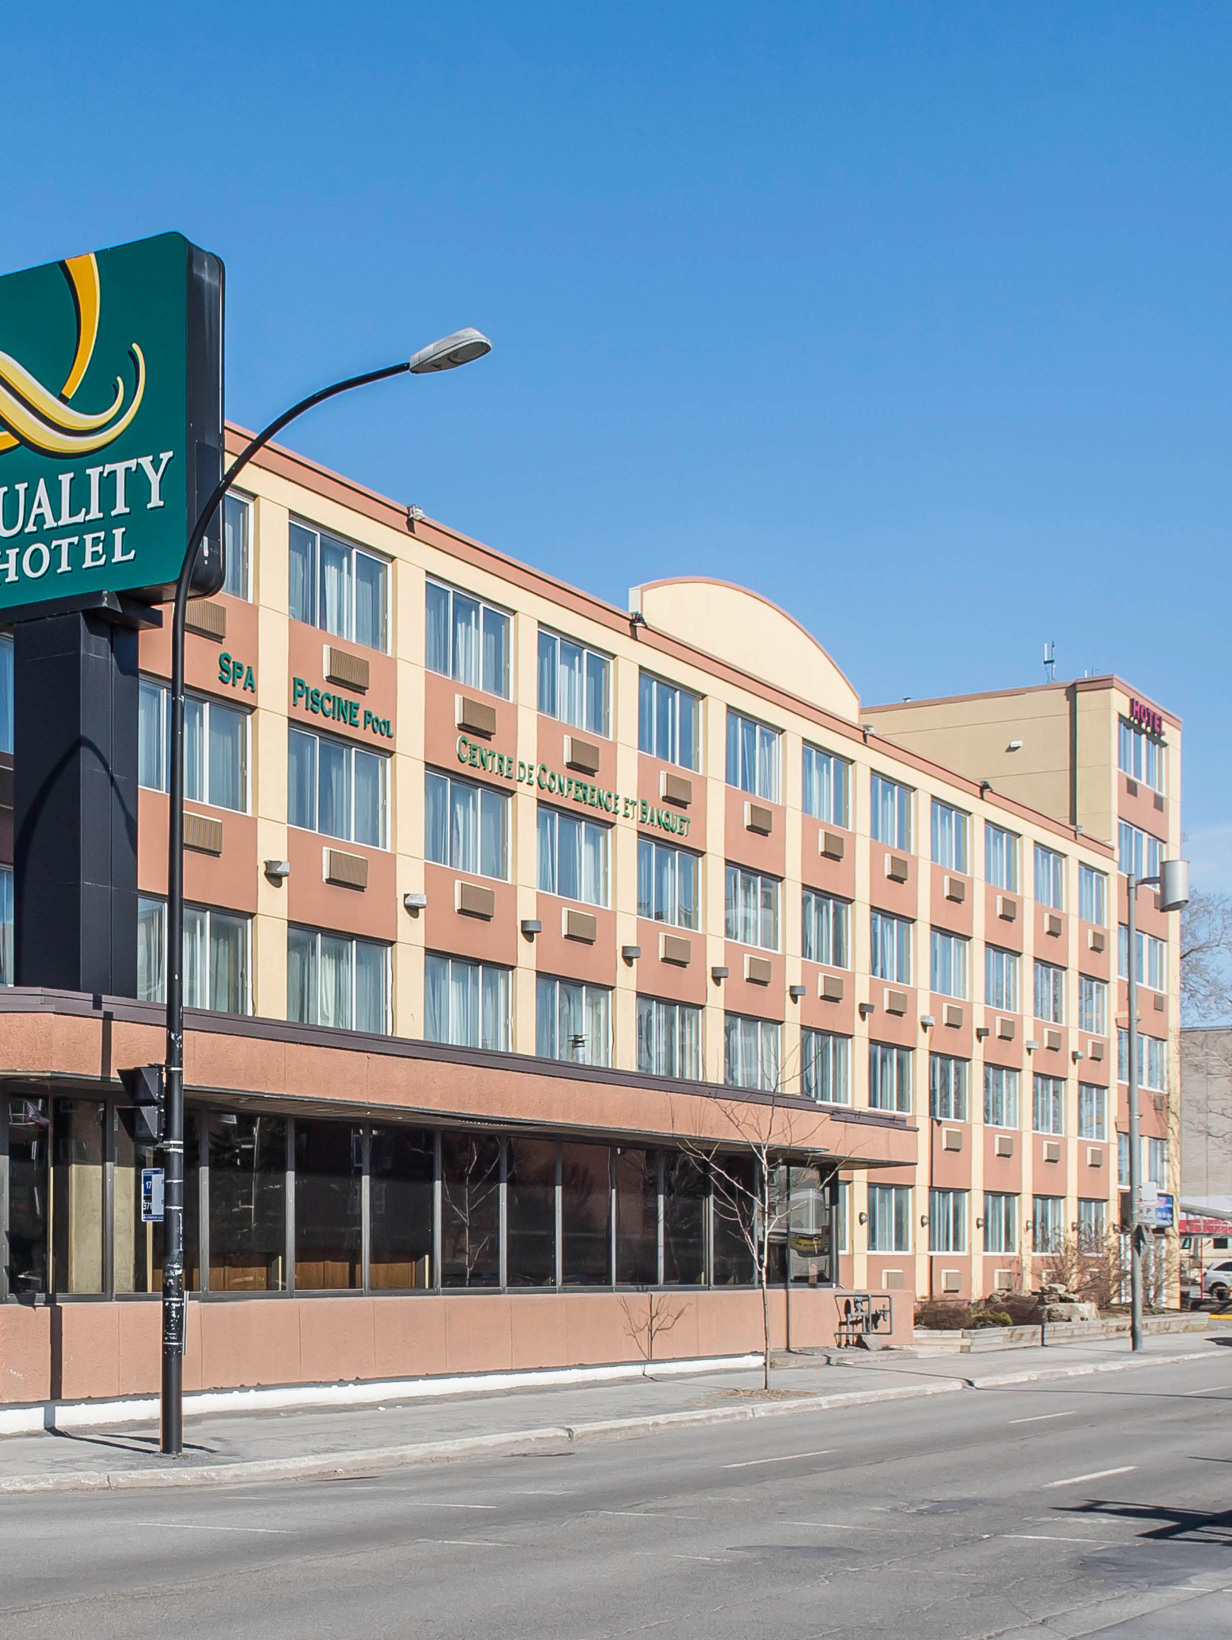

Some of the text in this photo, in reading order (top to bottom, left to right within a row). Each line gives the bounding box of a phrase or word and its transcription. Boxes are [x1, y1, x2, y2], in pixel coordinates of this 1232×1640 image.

[218, 652, 256, 693] SPA
[293, 677, 394, 738] PISCINE POOL
[456, 735, 514, 780] CENTRE
[516, 761, 535, 786] DE
[537, 764, 620, 815] CONFERENCE
[623, 797, 637, 820] ET
[146, 1181, 152, 1189] 17
